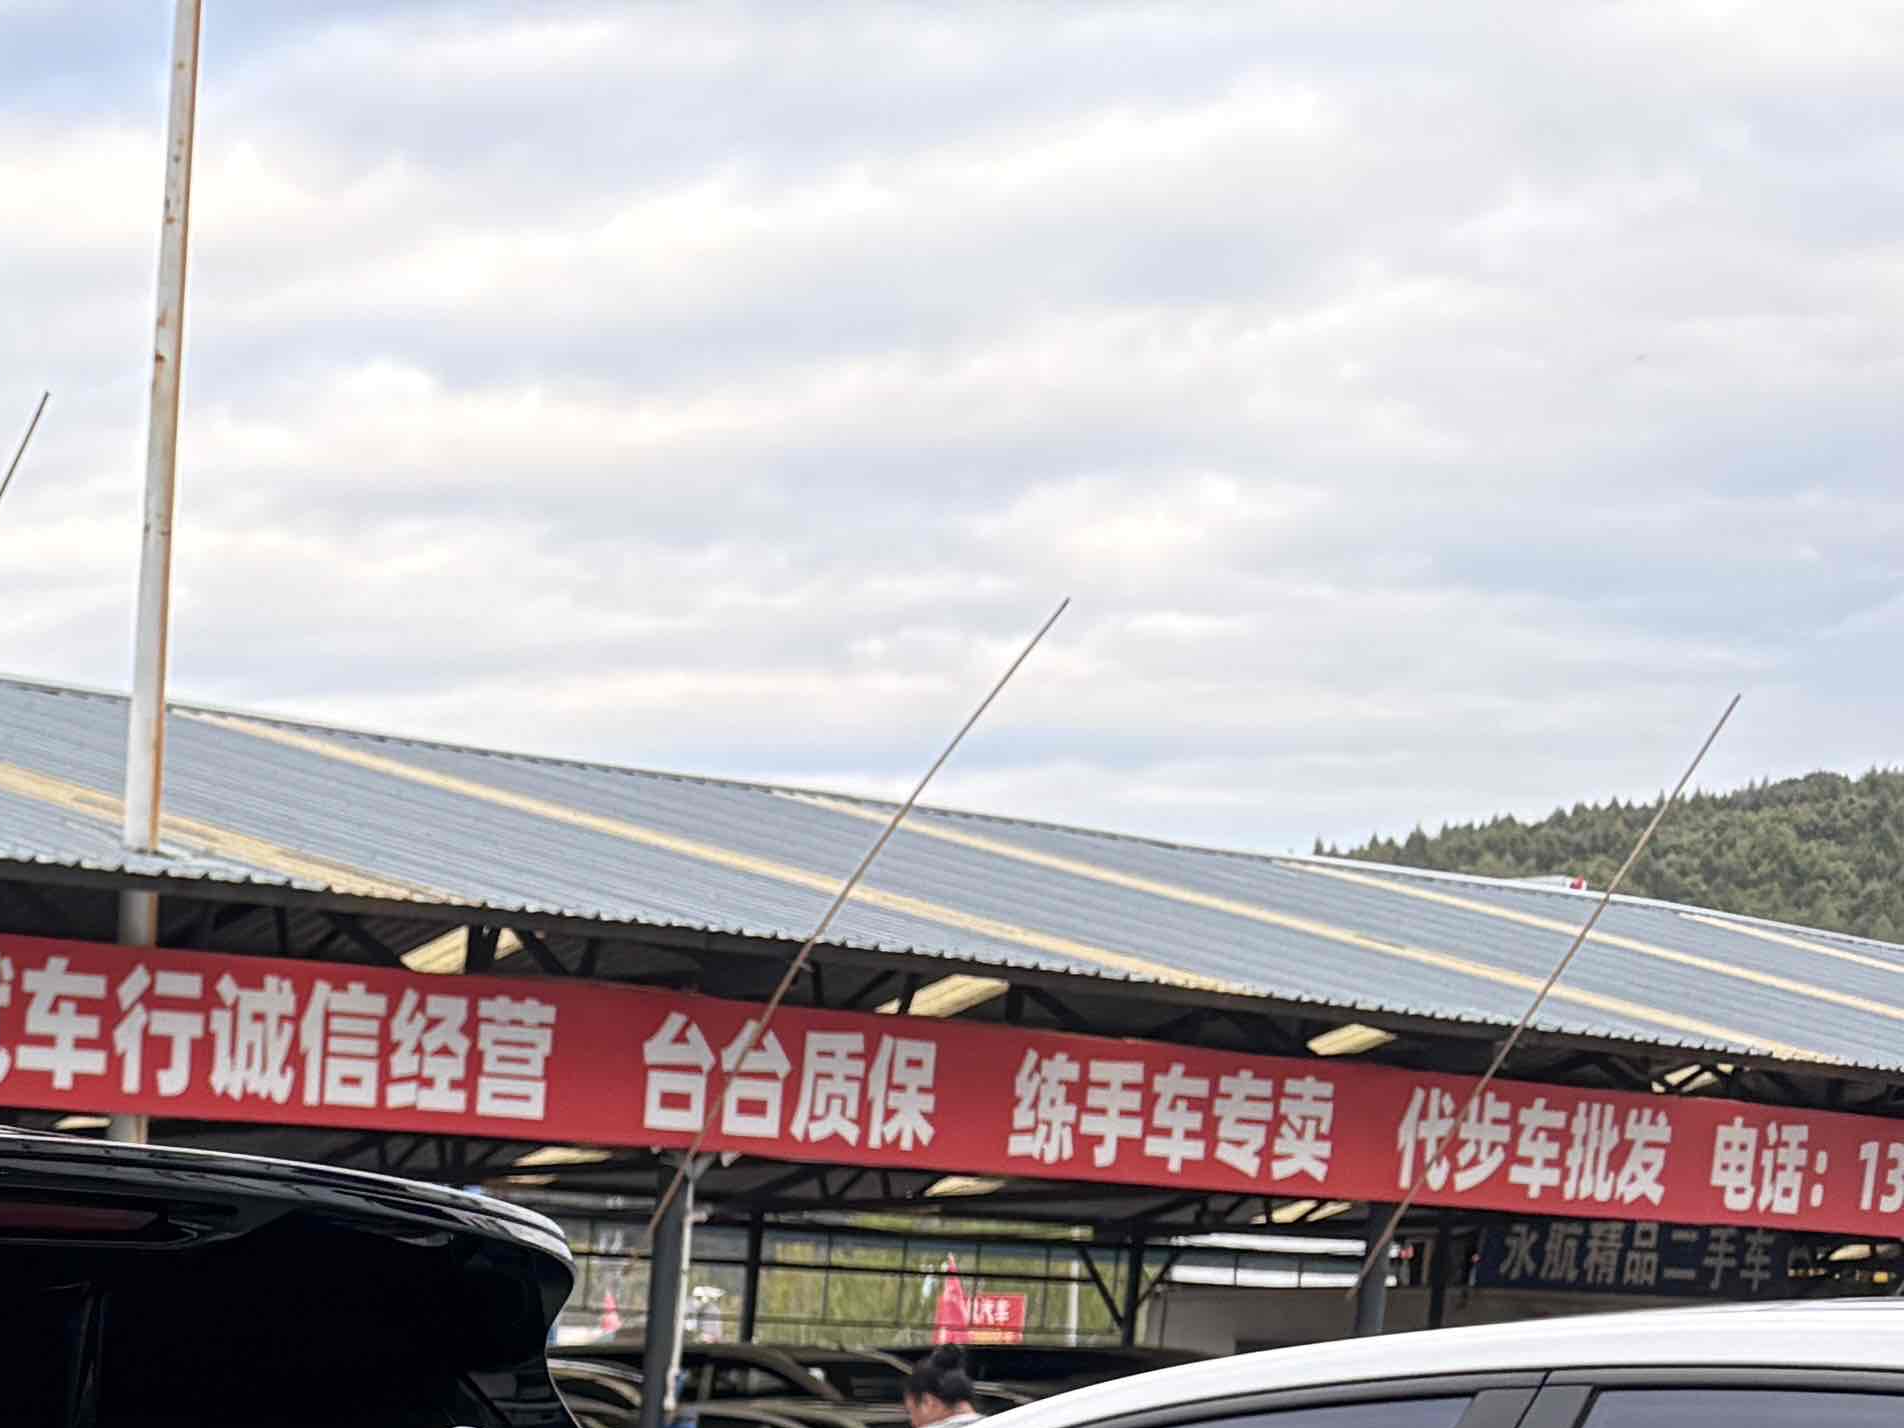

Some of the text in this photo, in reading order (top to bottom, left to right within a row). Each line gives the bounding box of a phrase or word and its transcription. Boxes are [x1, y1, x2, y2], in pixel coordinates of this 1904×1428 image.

[642, 1011, 938, 1152] 台台质保
[1007, 1047, 1335, 1183] 练手车专卖
[1398, 1086, 1672, 1207] 代步车批发
